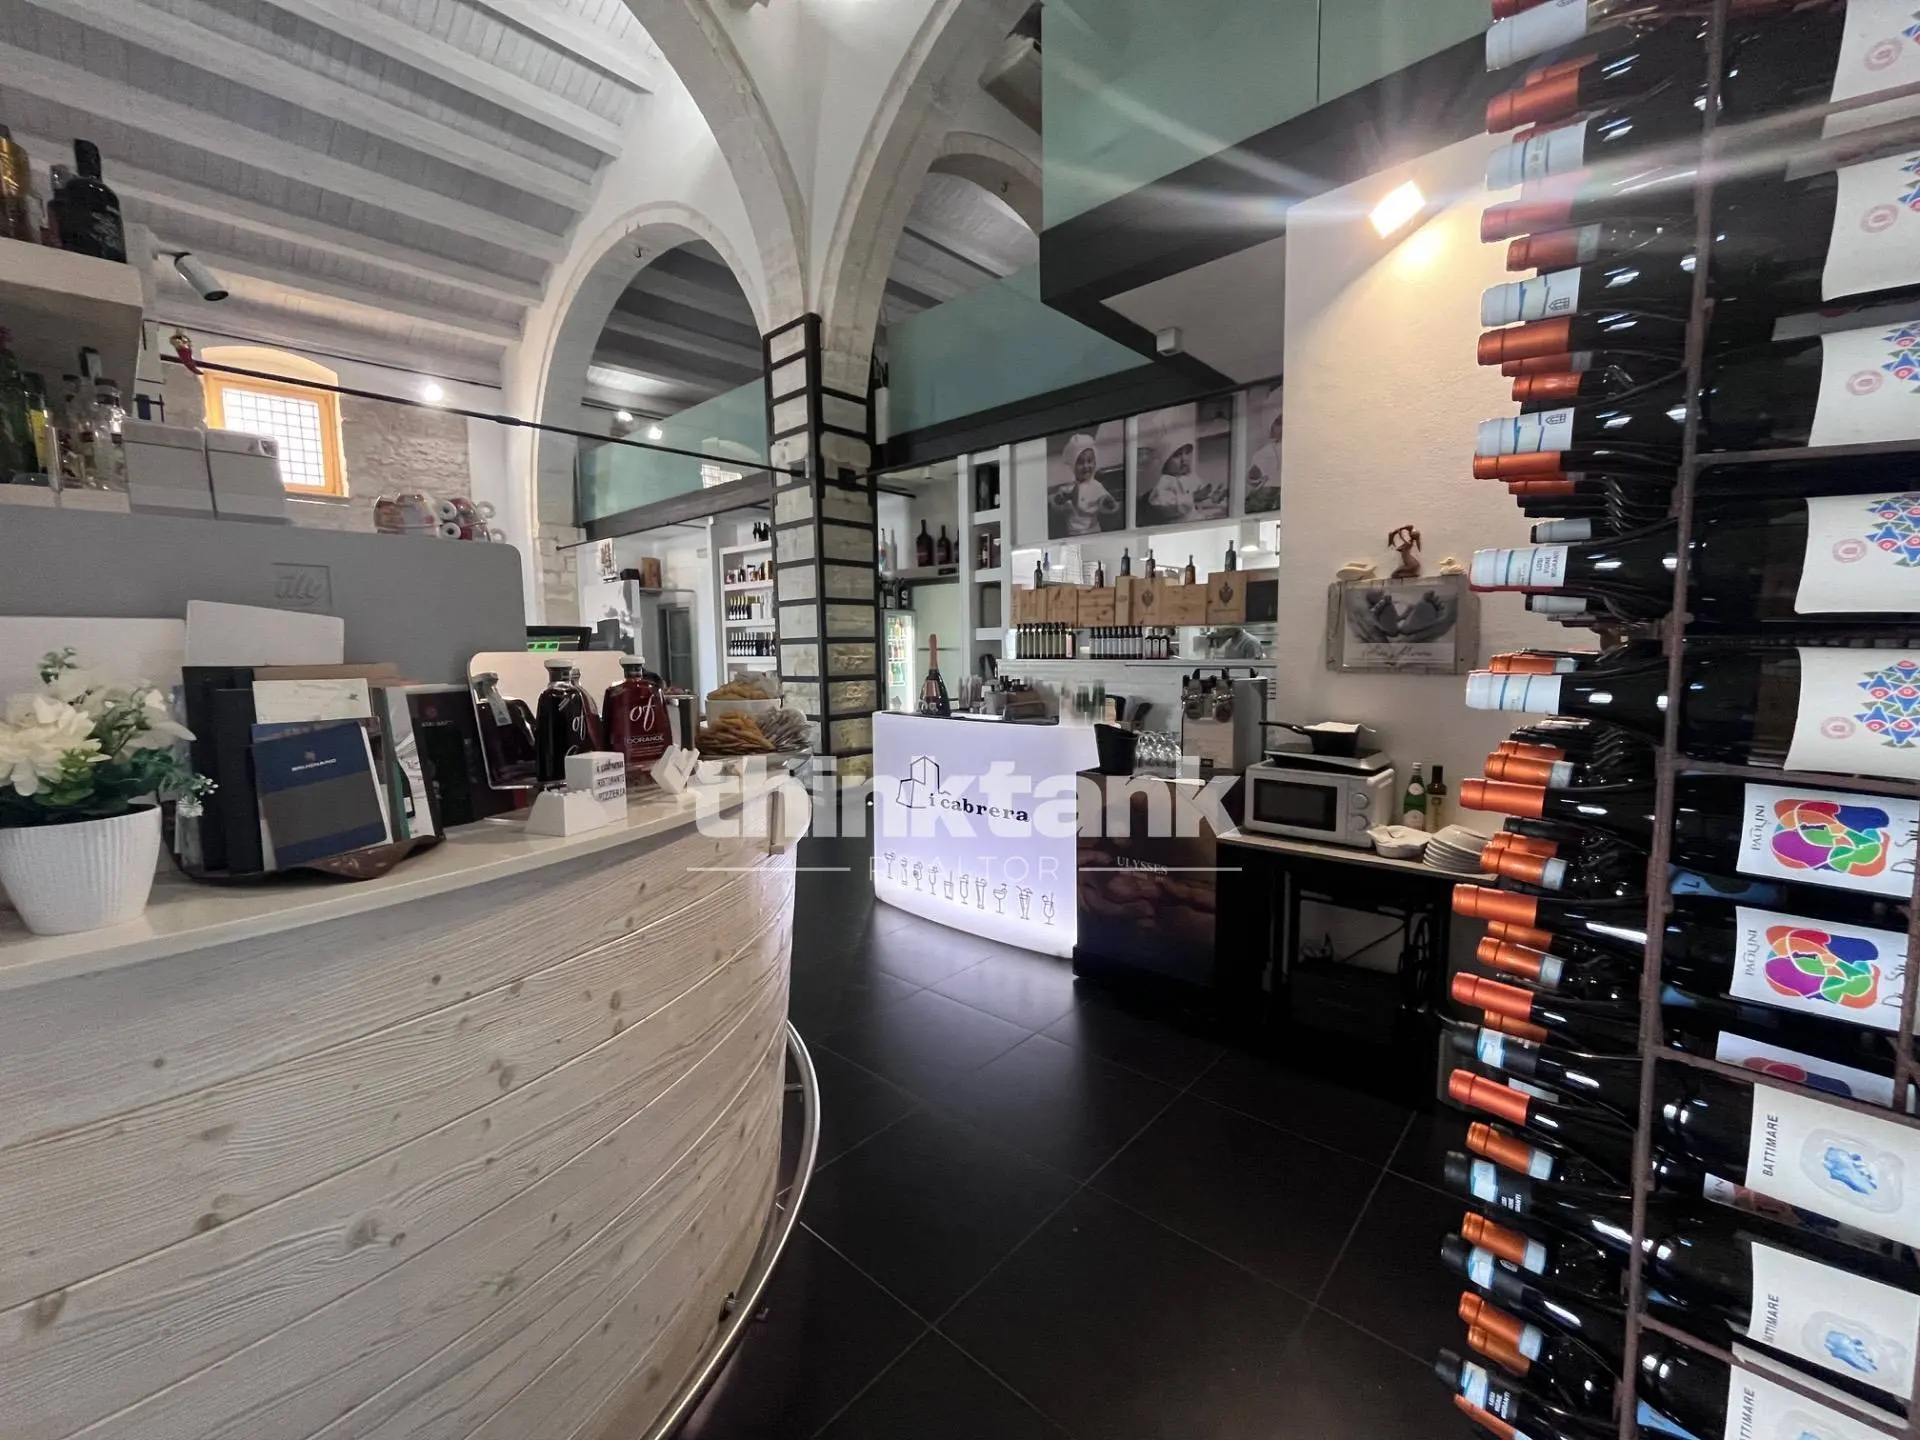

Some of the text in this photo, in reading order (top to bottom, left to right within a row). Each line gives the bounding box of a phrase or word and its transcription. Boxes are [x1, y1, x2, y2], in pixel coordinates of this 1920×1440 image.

[928, 792, 1031, 823] i cabrera
[1116, 856, 1168, 876] ULYSSES
[1762, 1114, 1779, 1177] BATTIMARE
[1739, 1387, 1755, 1440] TTIMARE
